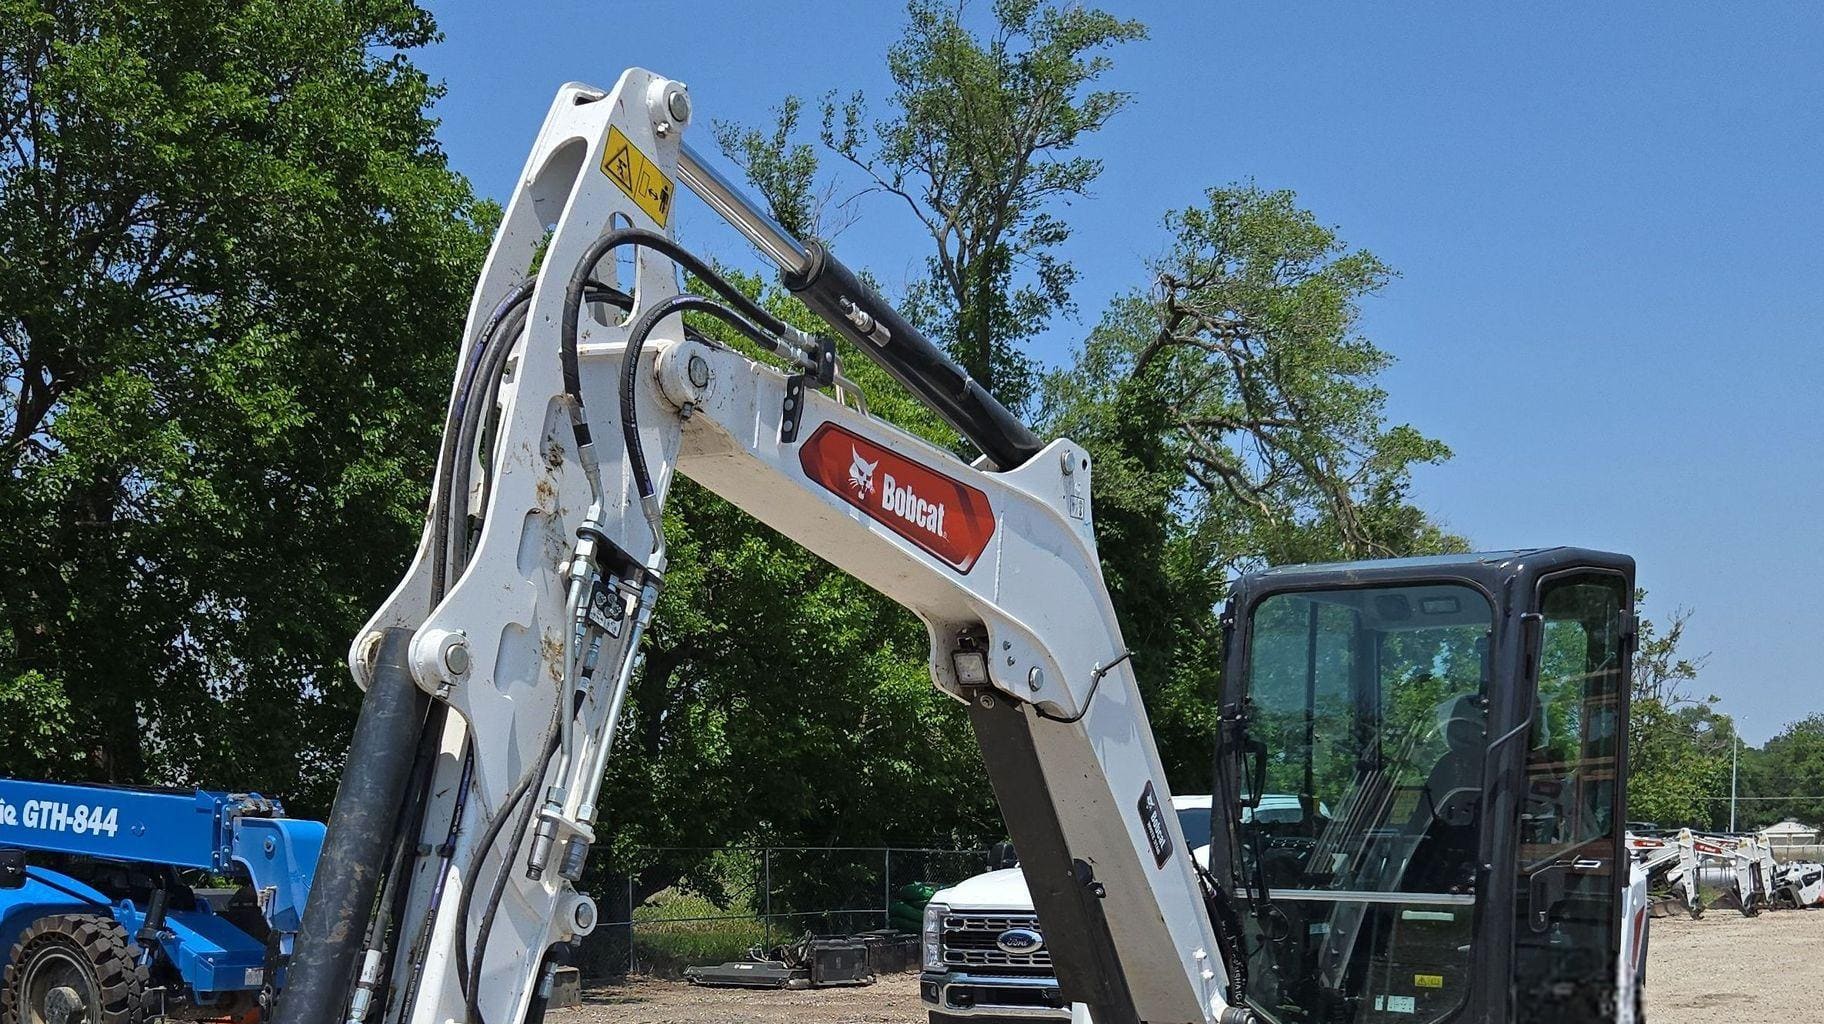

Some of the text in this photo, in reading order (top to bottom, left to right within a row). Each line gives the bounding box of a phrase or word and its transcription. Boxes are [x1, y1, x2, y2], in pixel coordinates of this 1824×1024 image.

[882, 473, 945, 537] Bobcat
[23, 799, 118, 837] GTH-844
[1150, 811, 1167, 849] Bobcat
